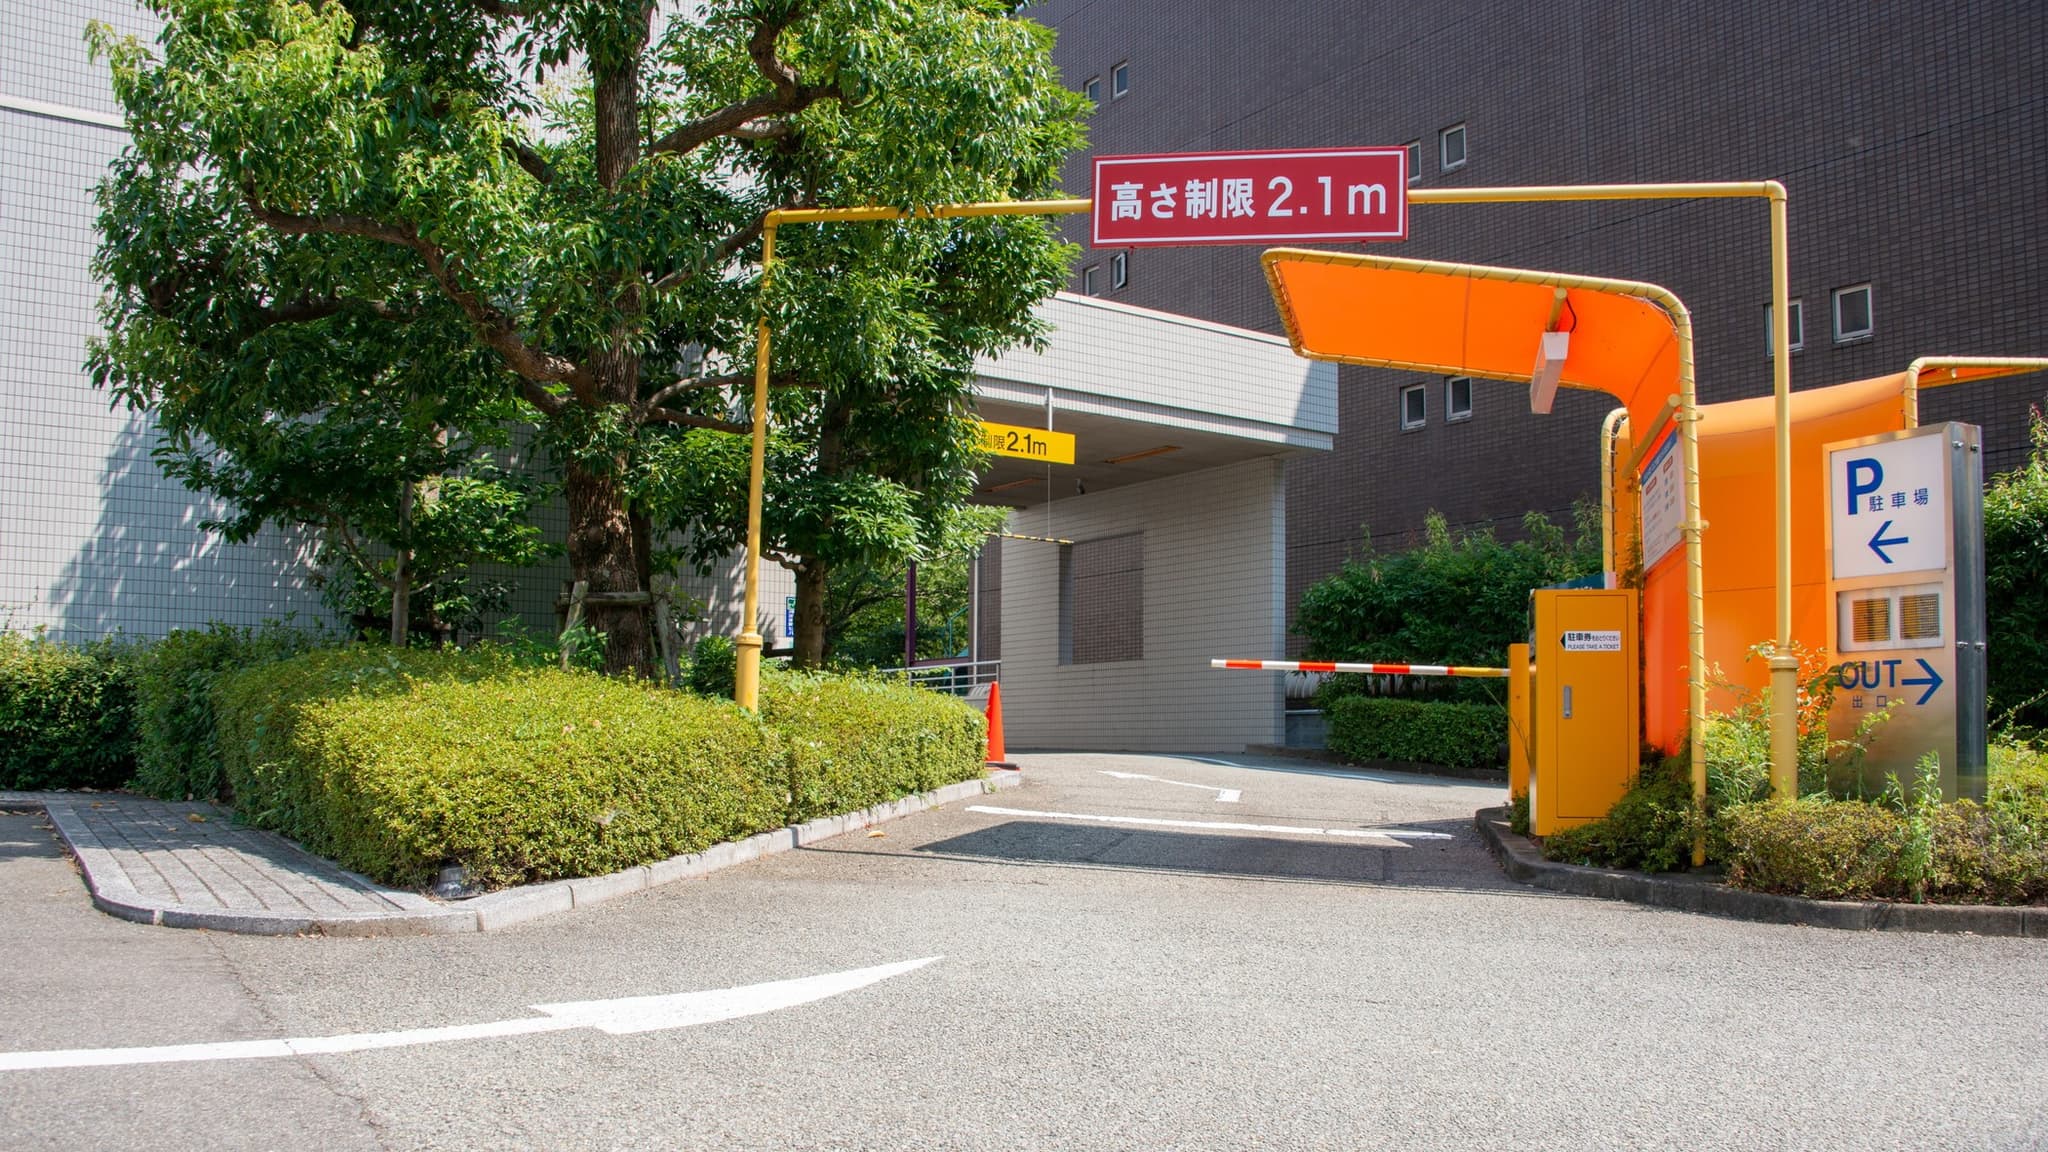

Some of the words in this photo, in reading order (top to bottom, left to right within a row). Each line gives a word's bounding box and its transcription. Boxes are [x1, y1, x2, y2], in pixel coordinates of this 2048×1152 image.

[1110, 178, 1255, 221] 高さ制限
[1267, 176, 1386, 217] 2.1m
[1846, 457, 1884, 516] P
[1868, 488, 1929, 512] 駐車場
[1839, 659, 1902, 689] OUT
[1852, 695, 1887, 708] 出口
